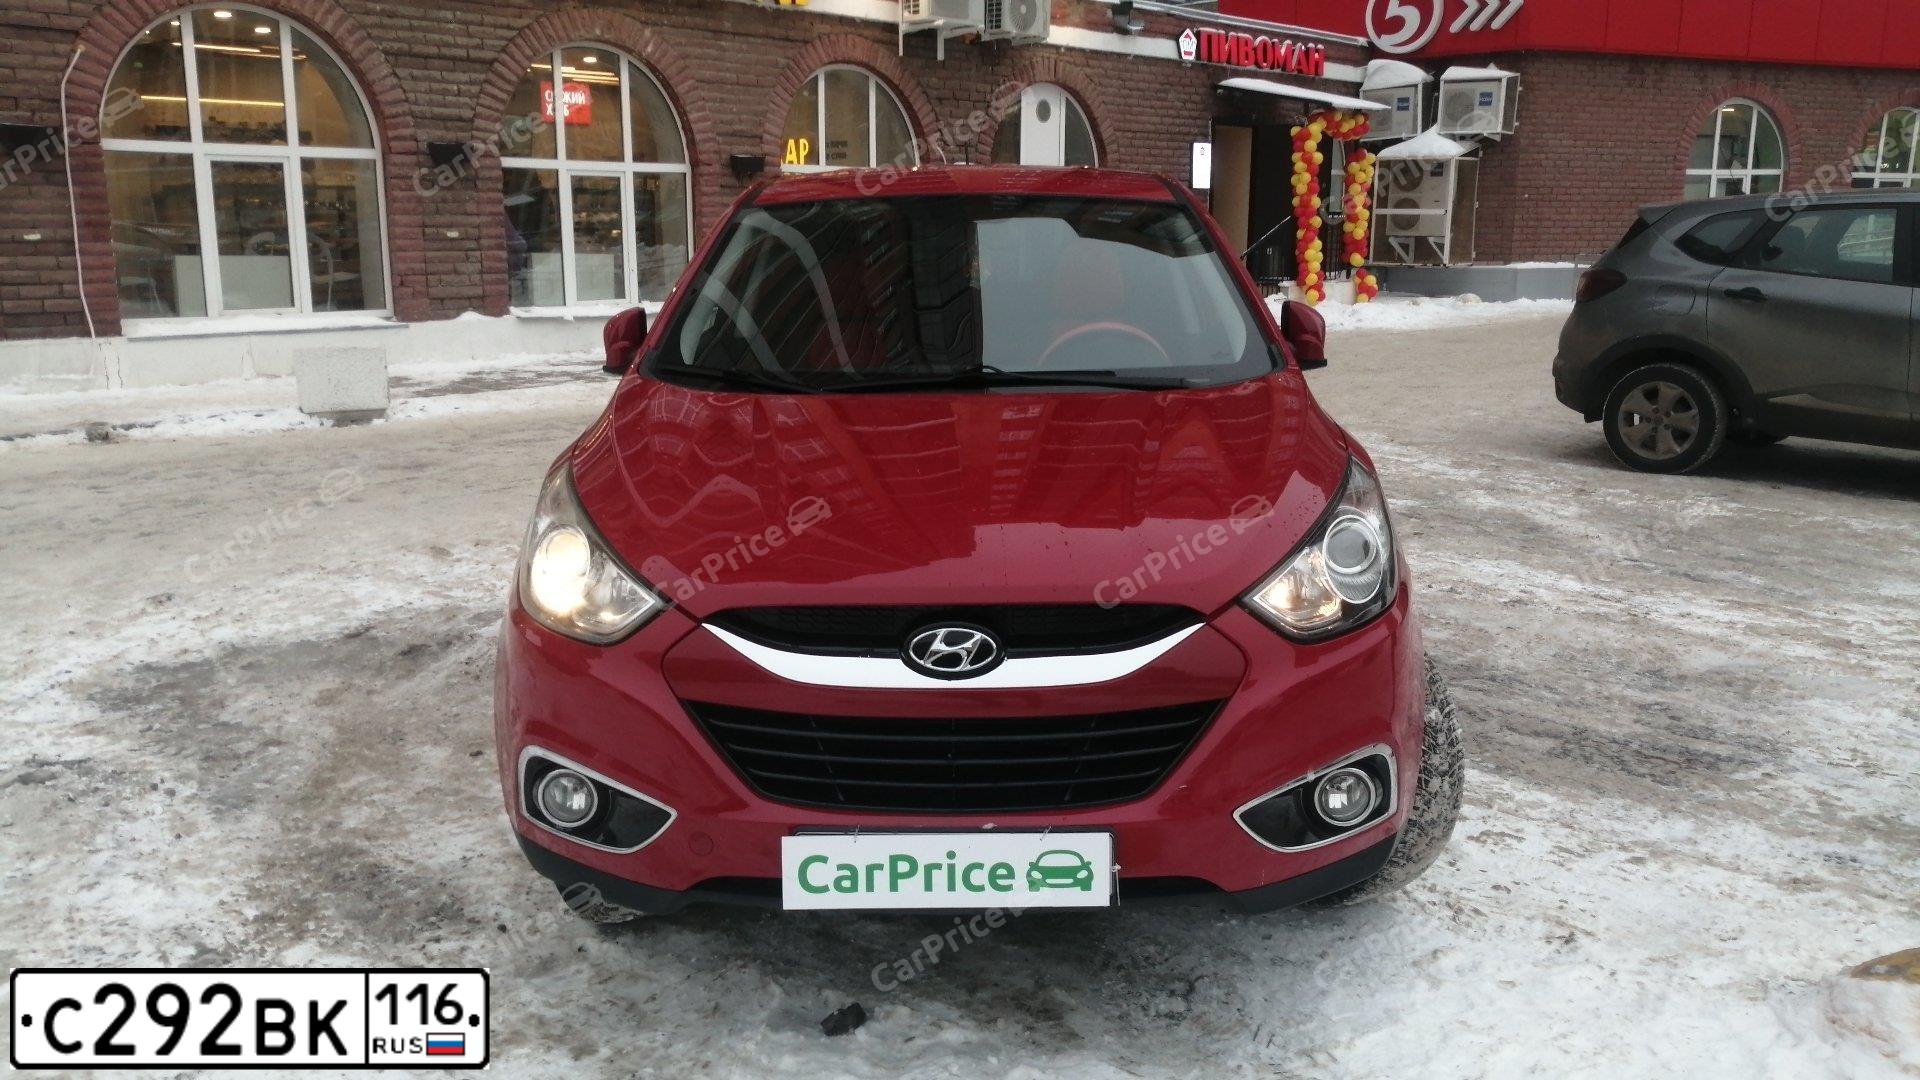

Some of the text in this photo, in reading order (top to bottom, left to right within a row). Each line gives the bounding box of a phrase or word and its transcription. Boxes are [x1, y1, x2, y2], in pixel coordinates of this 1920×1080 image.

[1380, 0, 1421, 46] 5
[1199, 28, 1325, 76] ПИВОМАН
[544, 90, 586, 104] СЖИЙ
[546, 103, 570, 117] ХБ
[780, 138, 809, 165] АР
[797, 850, 1016, 895] CarPrice
